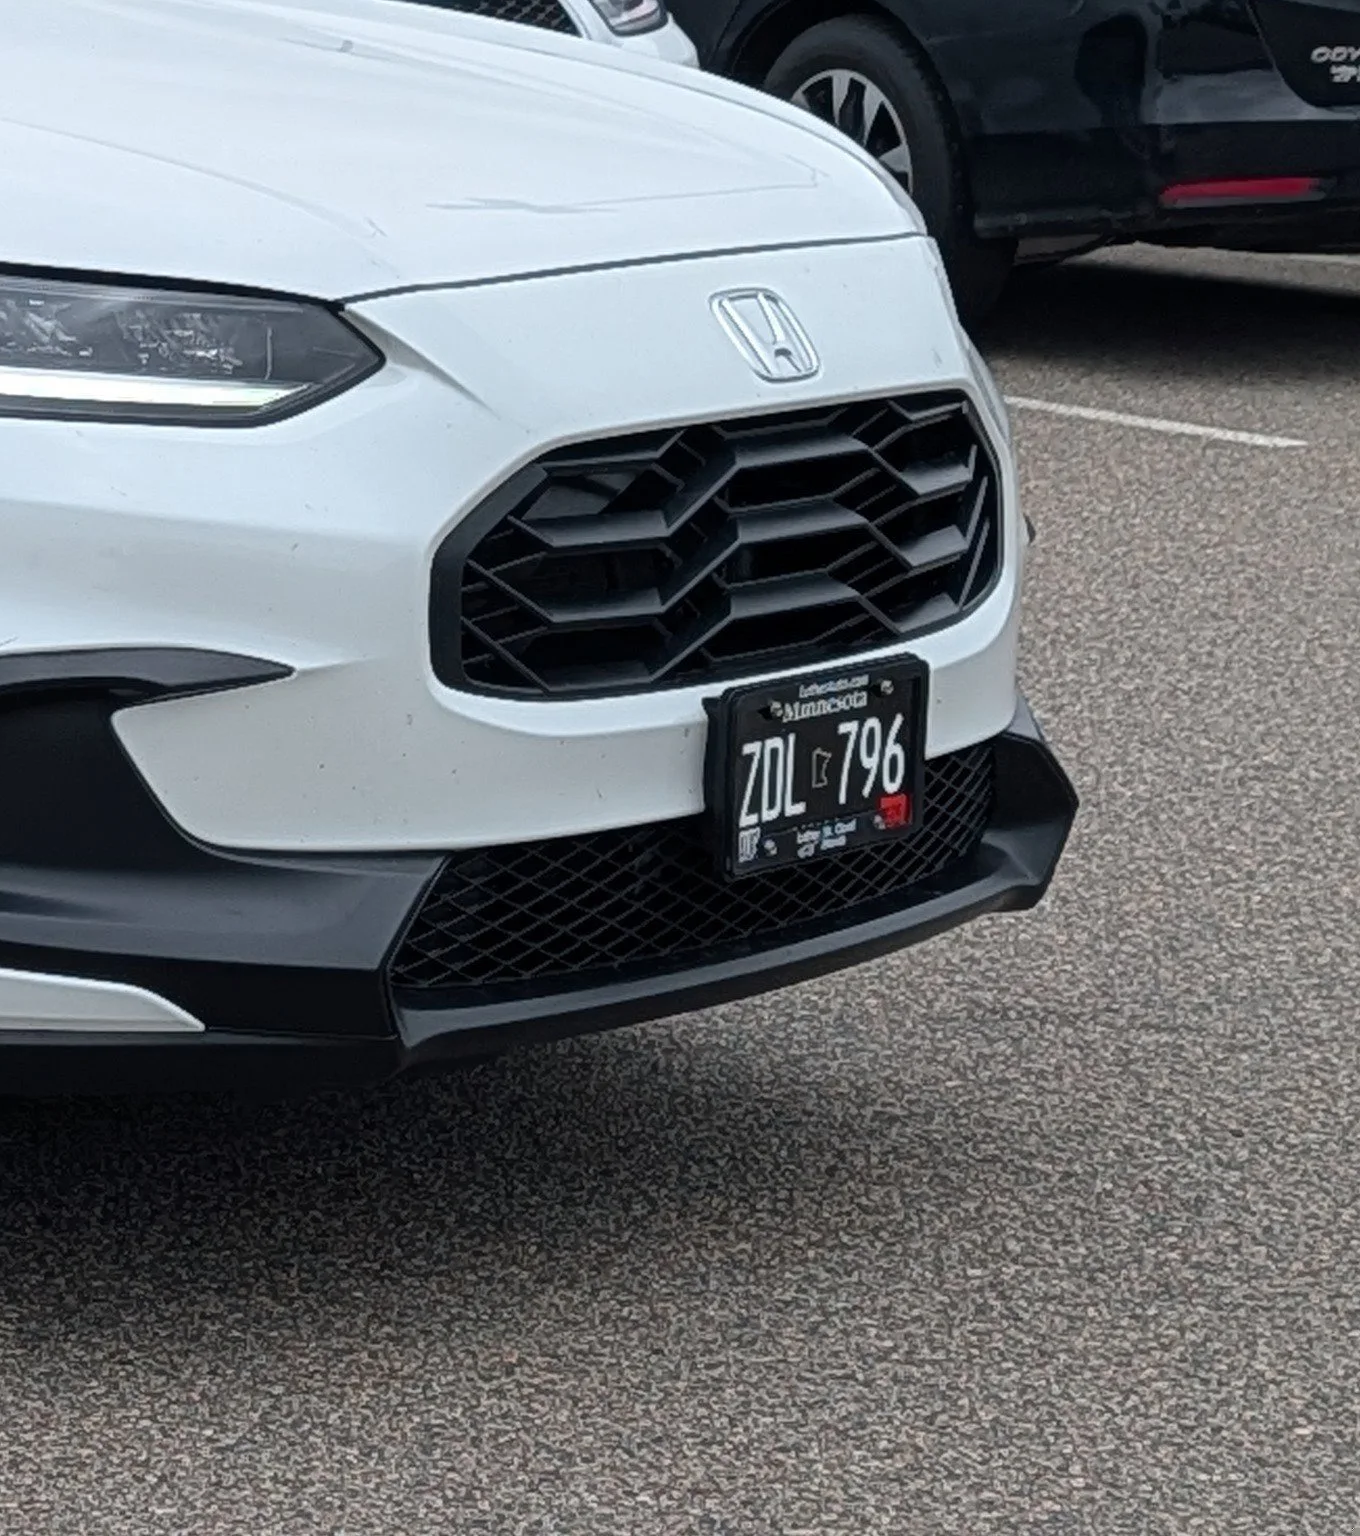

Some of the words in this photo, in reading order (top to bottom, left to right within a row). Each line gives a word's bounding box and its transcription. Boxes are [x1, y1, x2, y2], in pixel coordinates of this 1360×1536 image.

[782, 691, 867, 723] Minnesota
[738, 732, 806, 828] ZDL
[837, 713, 905, 805] 796
